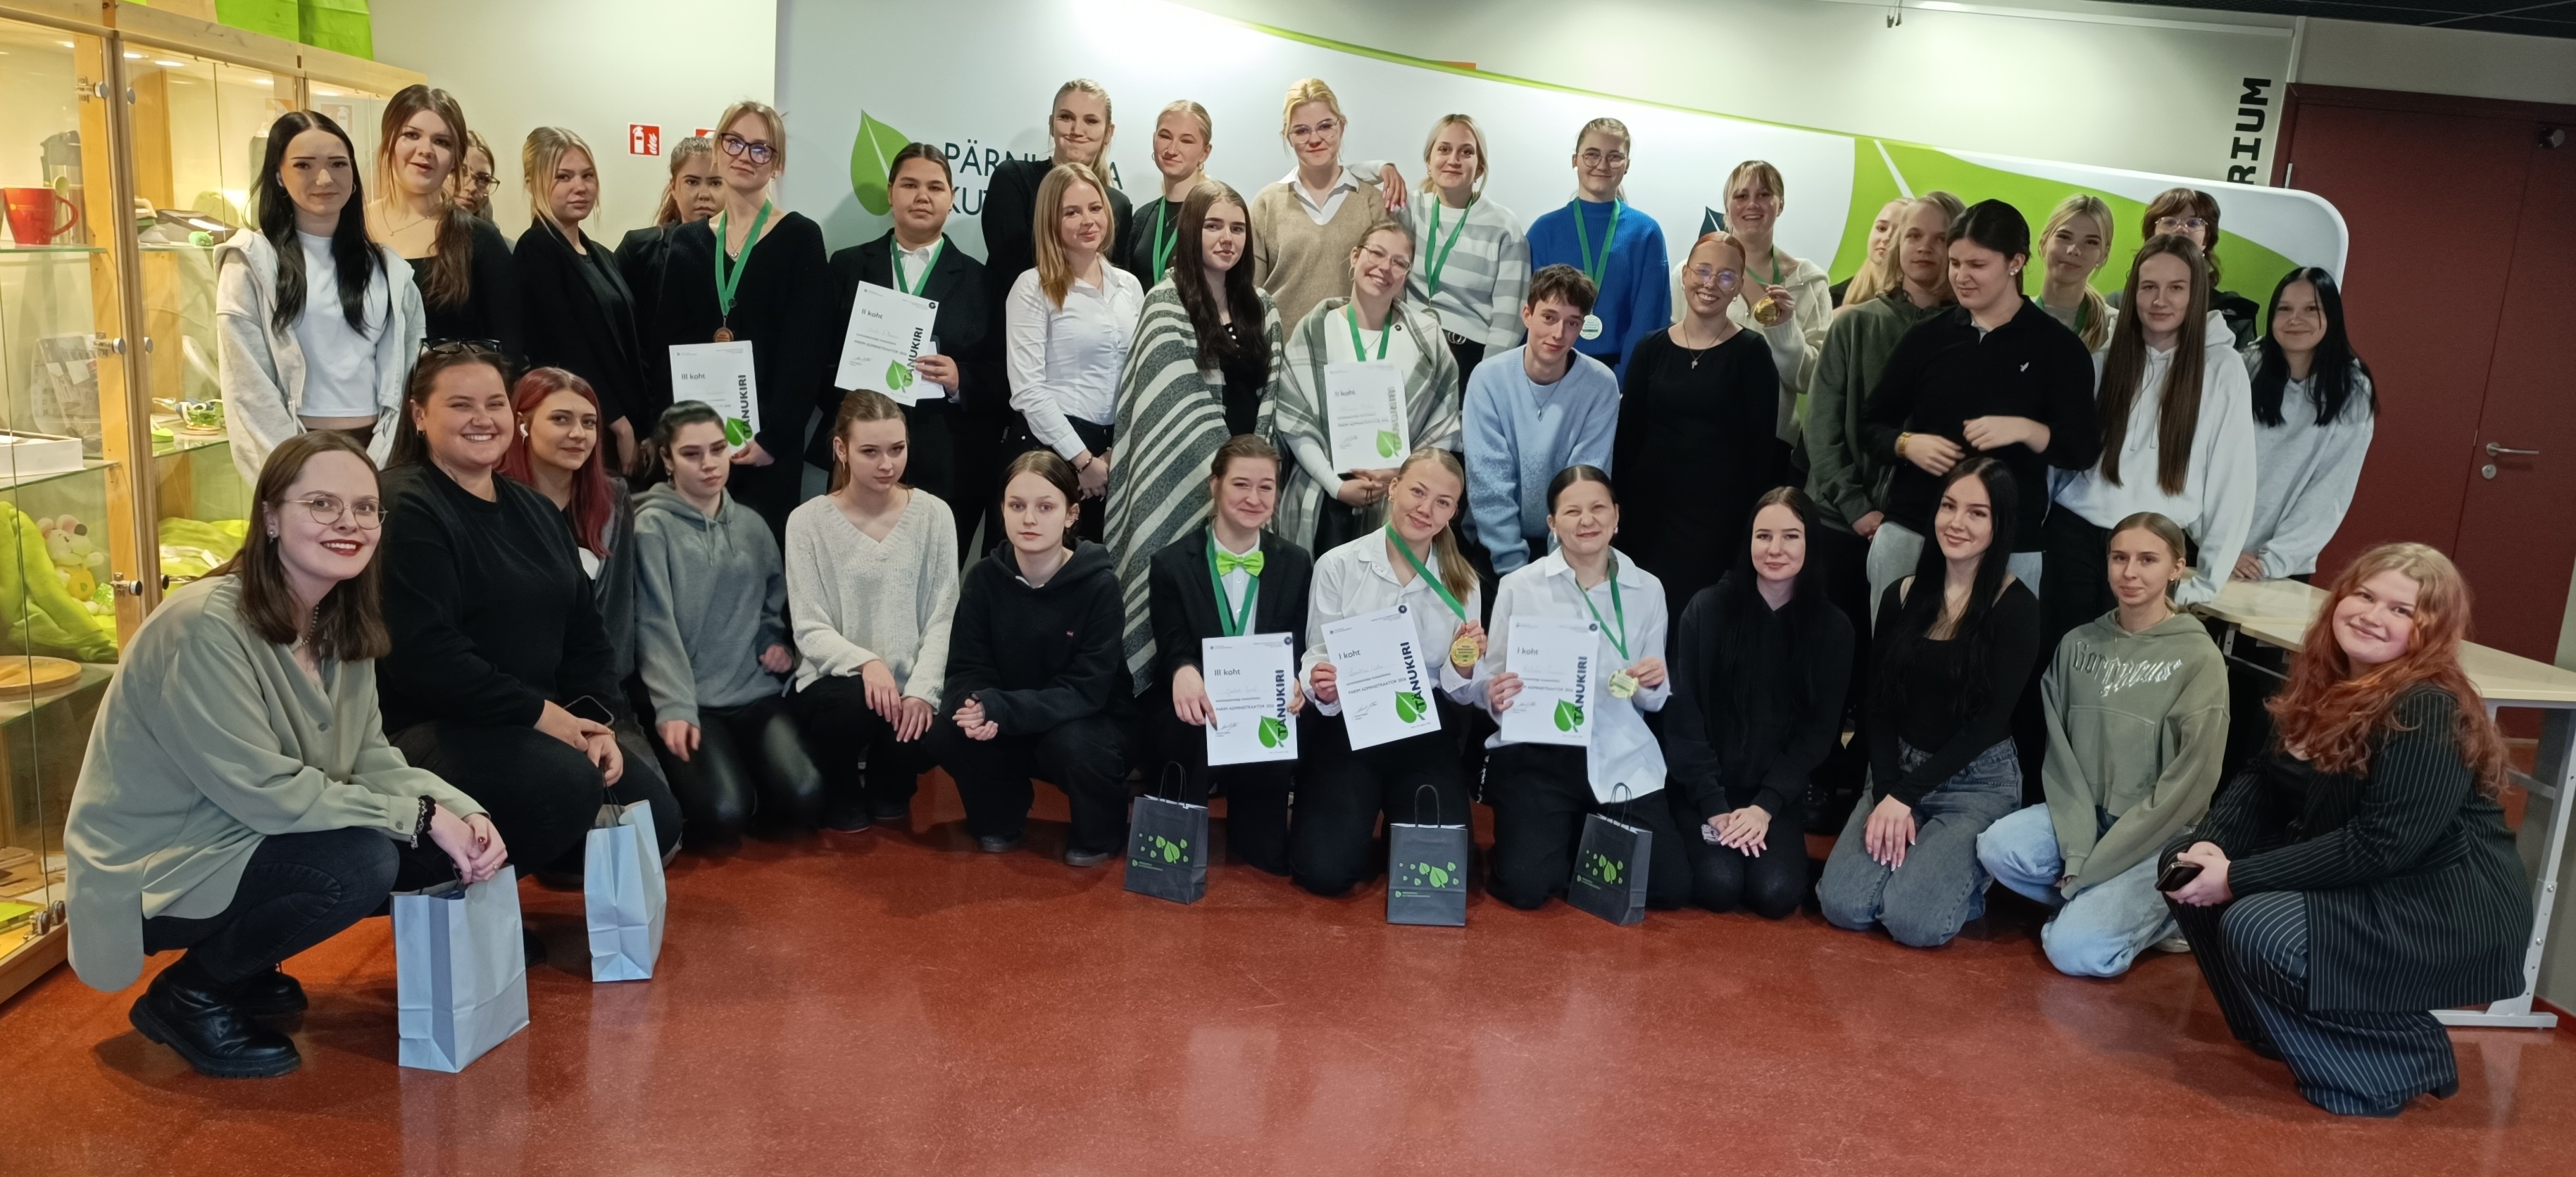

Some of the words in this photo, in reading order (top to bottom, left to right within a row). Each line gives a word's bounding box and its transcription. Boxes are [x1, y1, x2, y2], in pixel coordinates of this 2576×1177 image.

[867, 310, 883, 320] koht
[903, 327, 924, 384] TÄNUKIRI
[737, 374, 751, 436] TÄNUKIRI
[1343, 650, 1361, 660] koht
[1400, 641, 1425, 710] TÄNUKIRI
[1521, 646, 1539, 656] koht
[1275, 669, 1288, 737] TÄNUKIRI
[1572, 655, 1588, 722] TÄNUKIRI
